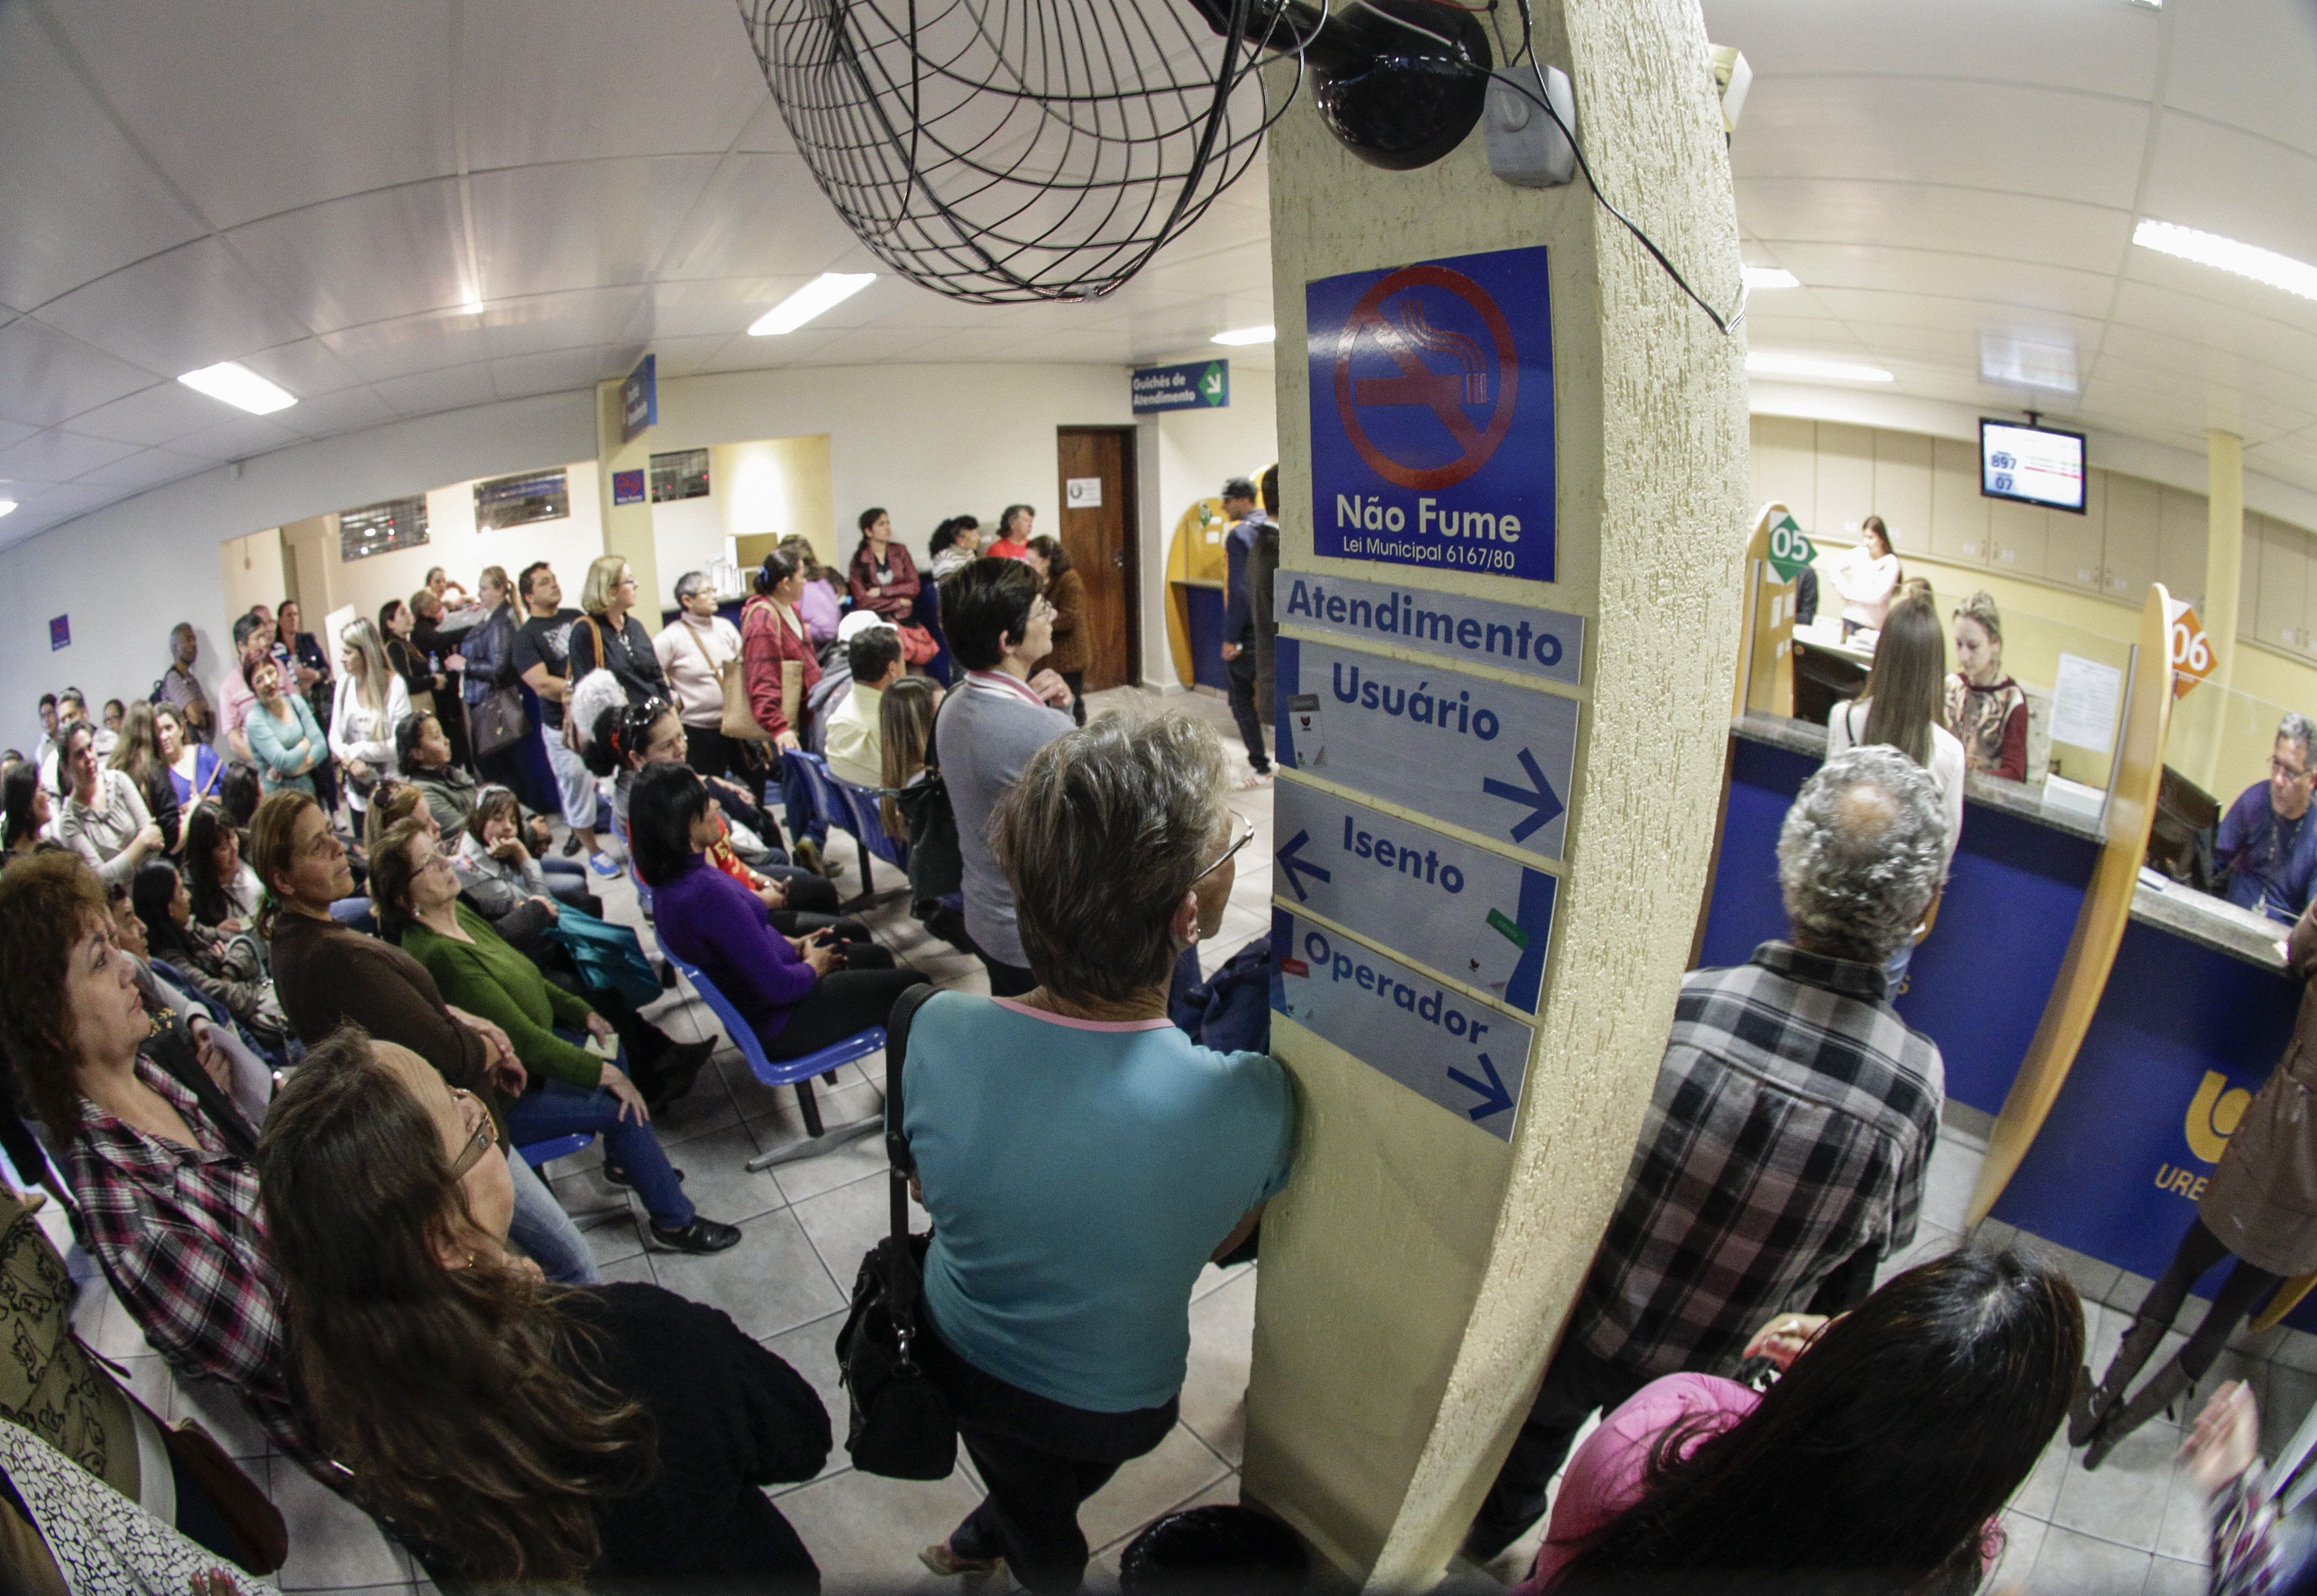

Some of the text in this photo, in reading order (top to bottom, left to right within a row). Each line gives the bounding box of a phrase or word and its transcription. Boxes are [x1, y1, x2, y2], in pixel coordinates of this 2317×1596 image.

[1133, 390, 1196, 406] Atendimento
[1172, 373, 1186, 386] de
[1991, 455, 2017, 470] 897
[1996, 477, 2012, 490] 07
[1337, 494, 1521, 542] Não Fume
[1343, 536, 1515, 570] Lei Municipal 6167/80
[1772, 527, 1809, 561] 05
[1287, 580, 1563, 666] Atendimento
[2173, 623, 2208, 671] 06
[1332, 662, 1500, 741] Usuário
[1343, 816, 1465, 894] Isento
[1304, 931, 1488, 1044] Operador
